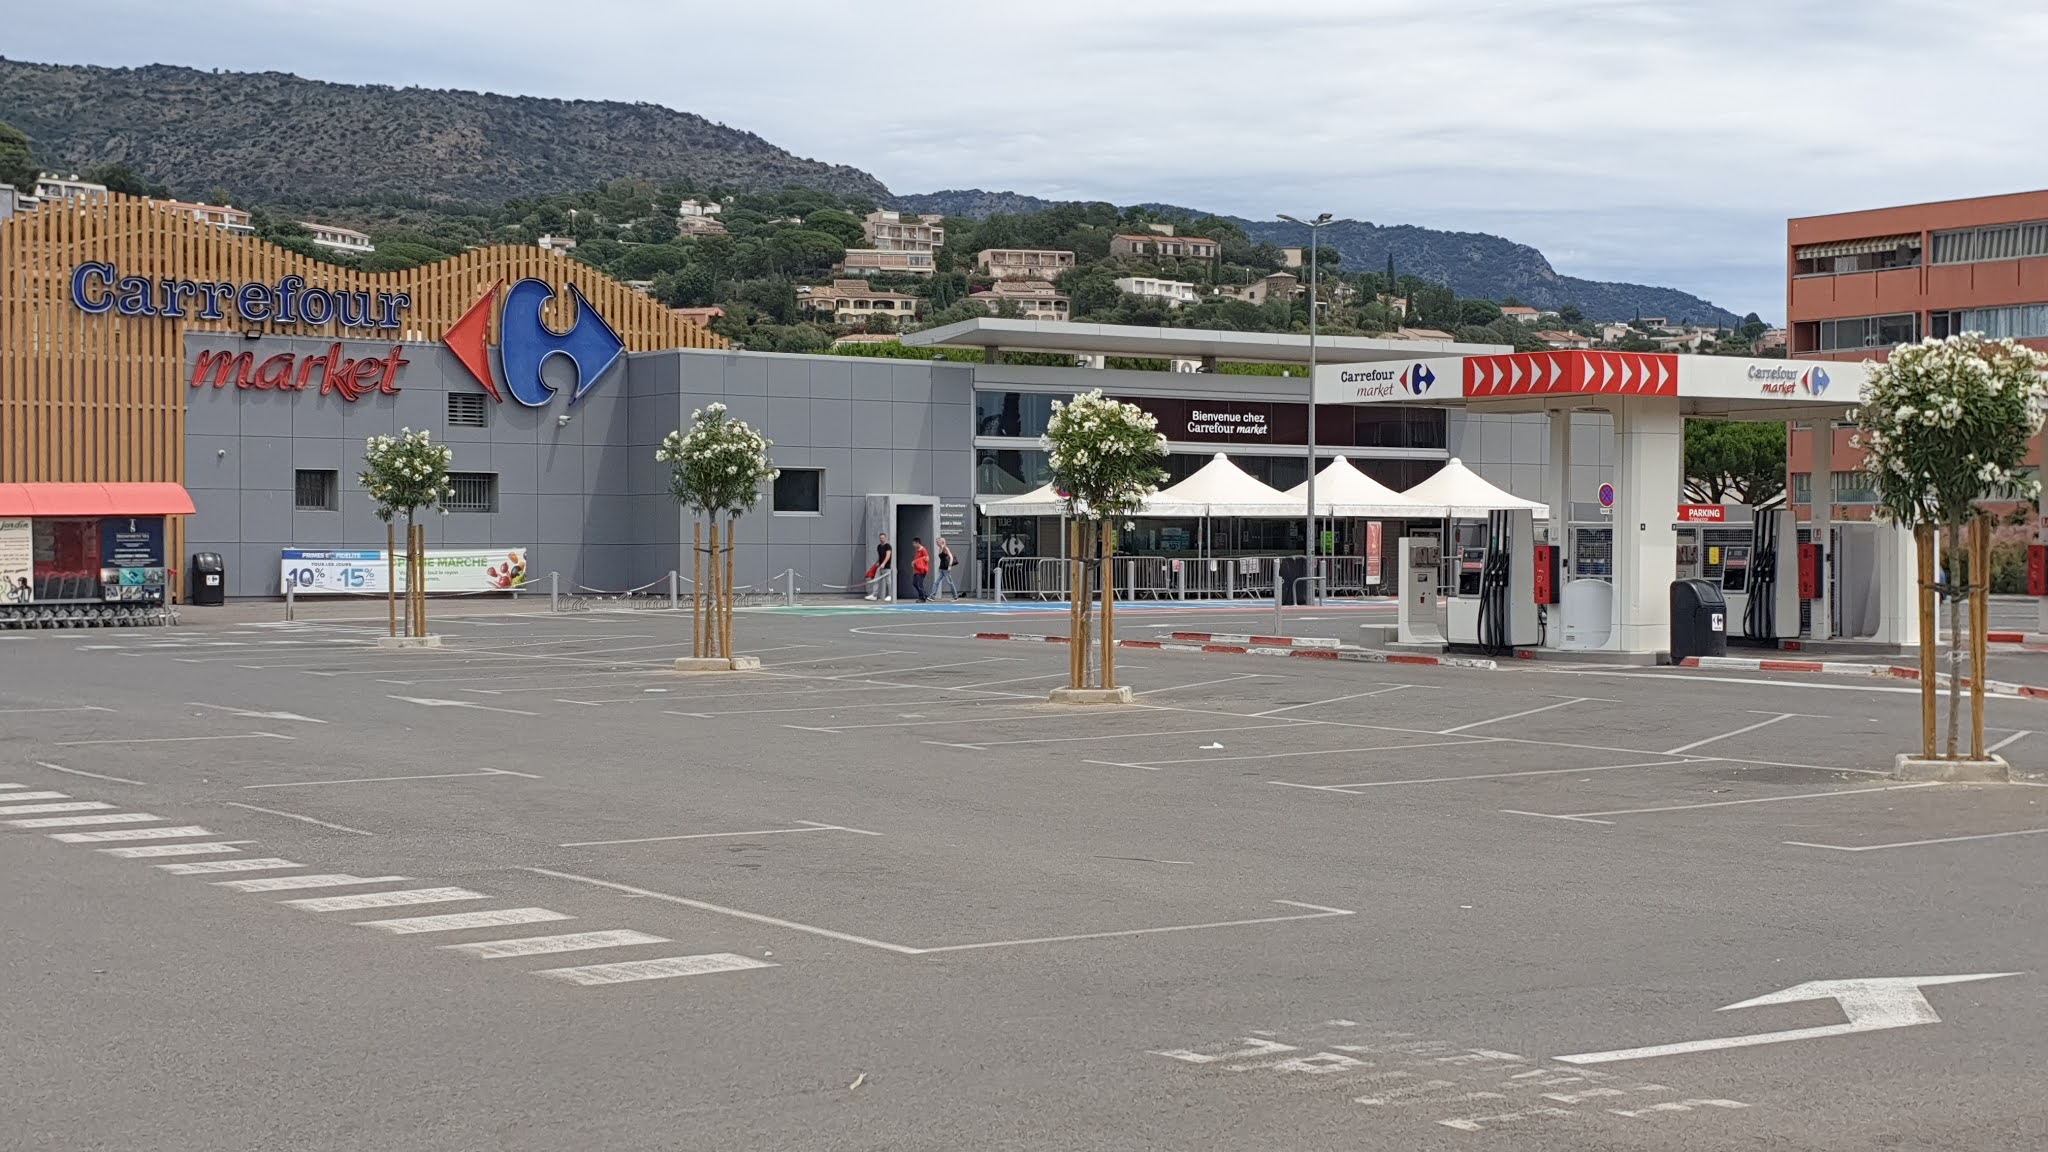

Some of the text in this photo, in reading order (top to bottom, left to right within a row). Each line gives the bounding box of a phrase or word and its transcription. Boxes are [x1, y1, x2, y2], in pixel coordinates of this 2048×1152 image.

[71, 261, 411, 328] Carrefour
[191, 342, 410, 402] market
[1341, 369, 1395, 383] Carrefour
[1747, 364, 1798, 380] Carrefour
[1357, 383, 1395, 397] market
[1762, 381, 1796, 394] market
[1192, 410, 1265, 423] Bienvenue chez
[1187, 421, 1268, 435] Carrefour market
[1688, 508, 1720, 517] PARKING
